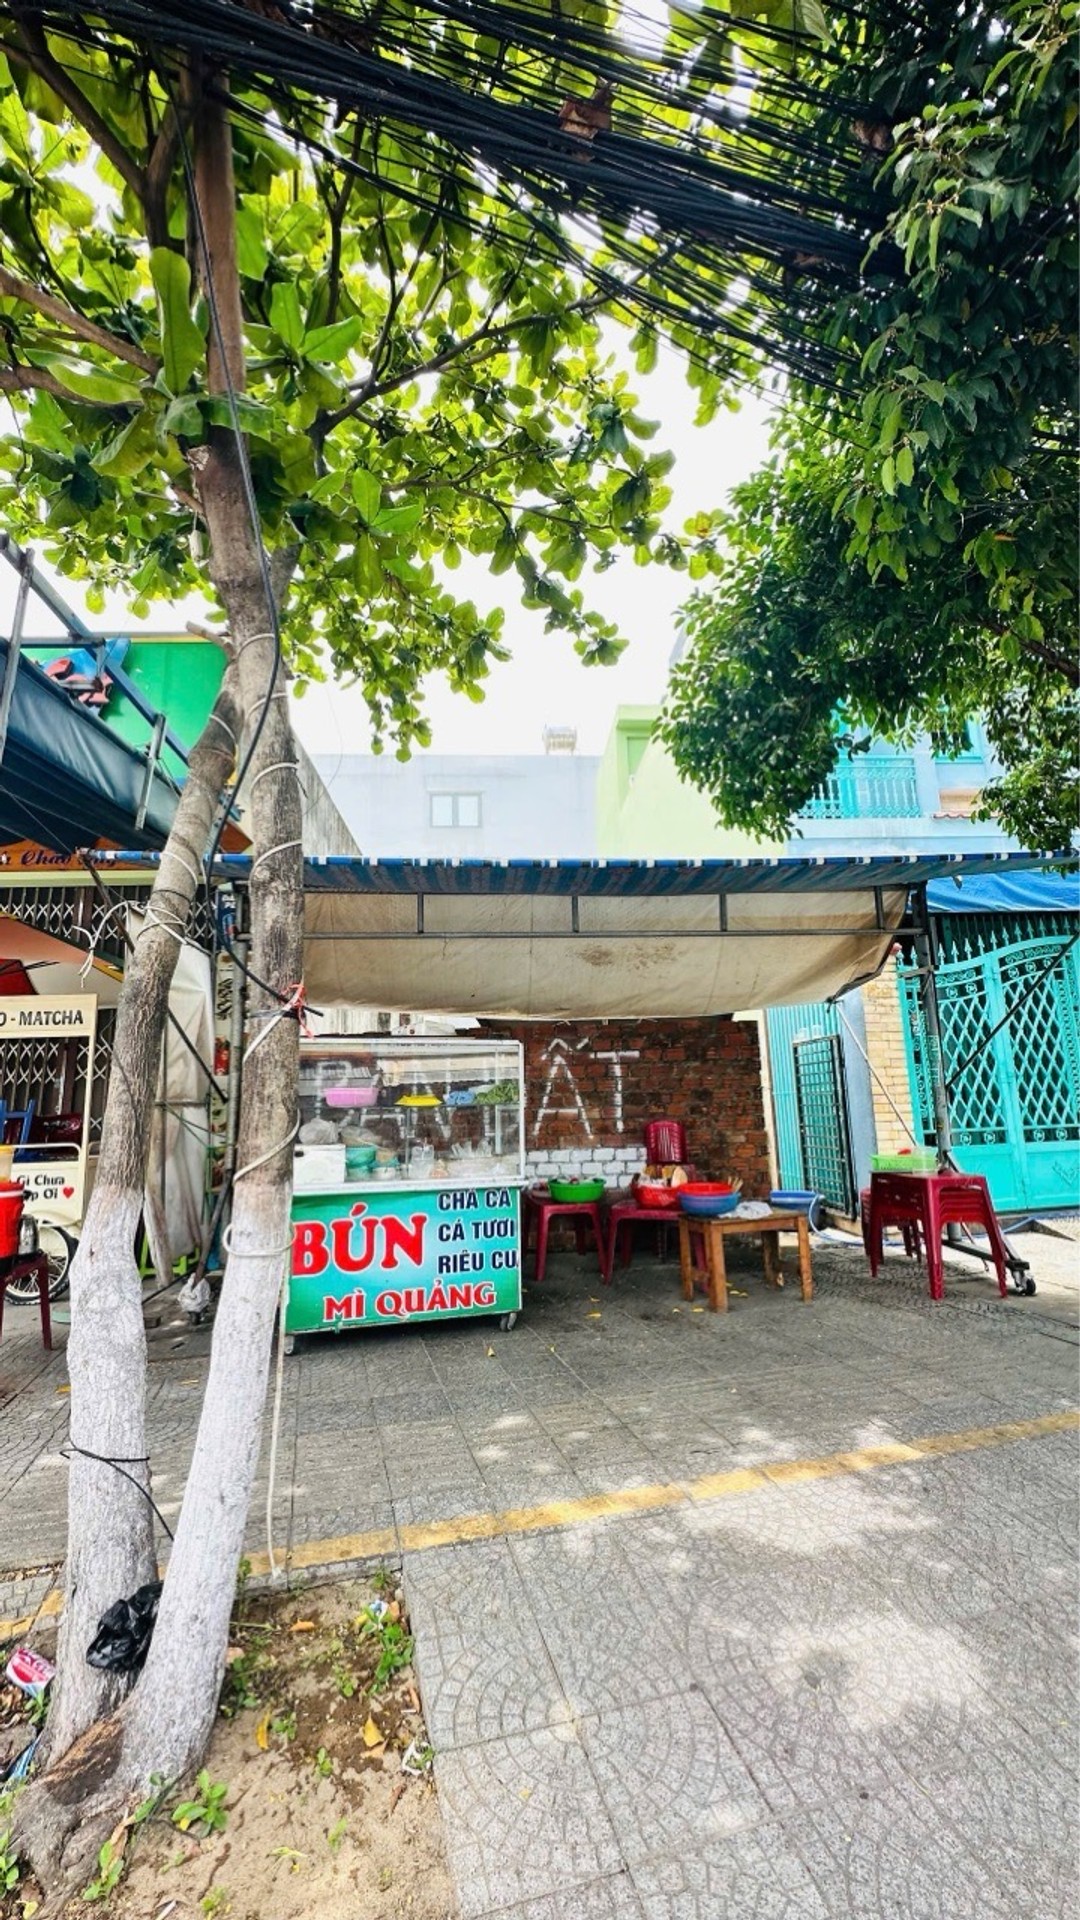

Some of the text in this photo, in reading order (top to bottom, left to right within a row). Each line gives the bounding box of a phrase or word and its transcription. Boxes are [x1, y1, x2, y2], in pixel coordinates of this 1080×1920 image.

[19, 1010, 84, 1026] MATCHA
[292, 1203, 427, 1275] BÚN
[438, 1218, 515, 1242] CÁ TƯƠI
[438, 1249, 518, 1274] RIÊU CU
[324, 1279, 496, 1321] MÌ QUẢNG
